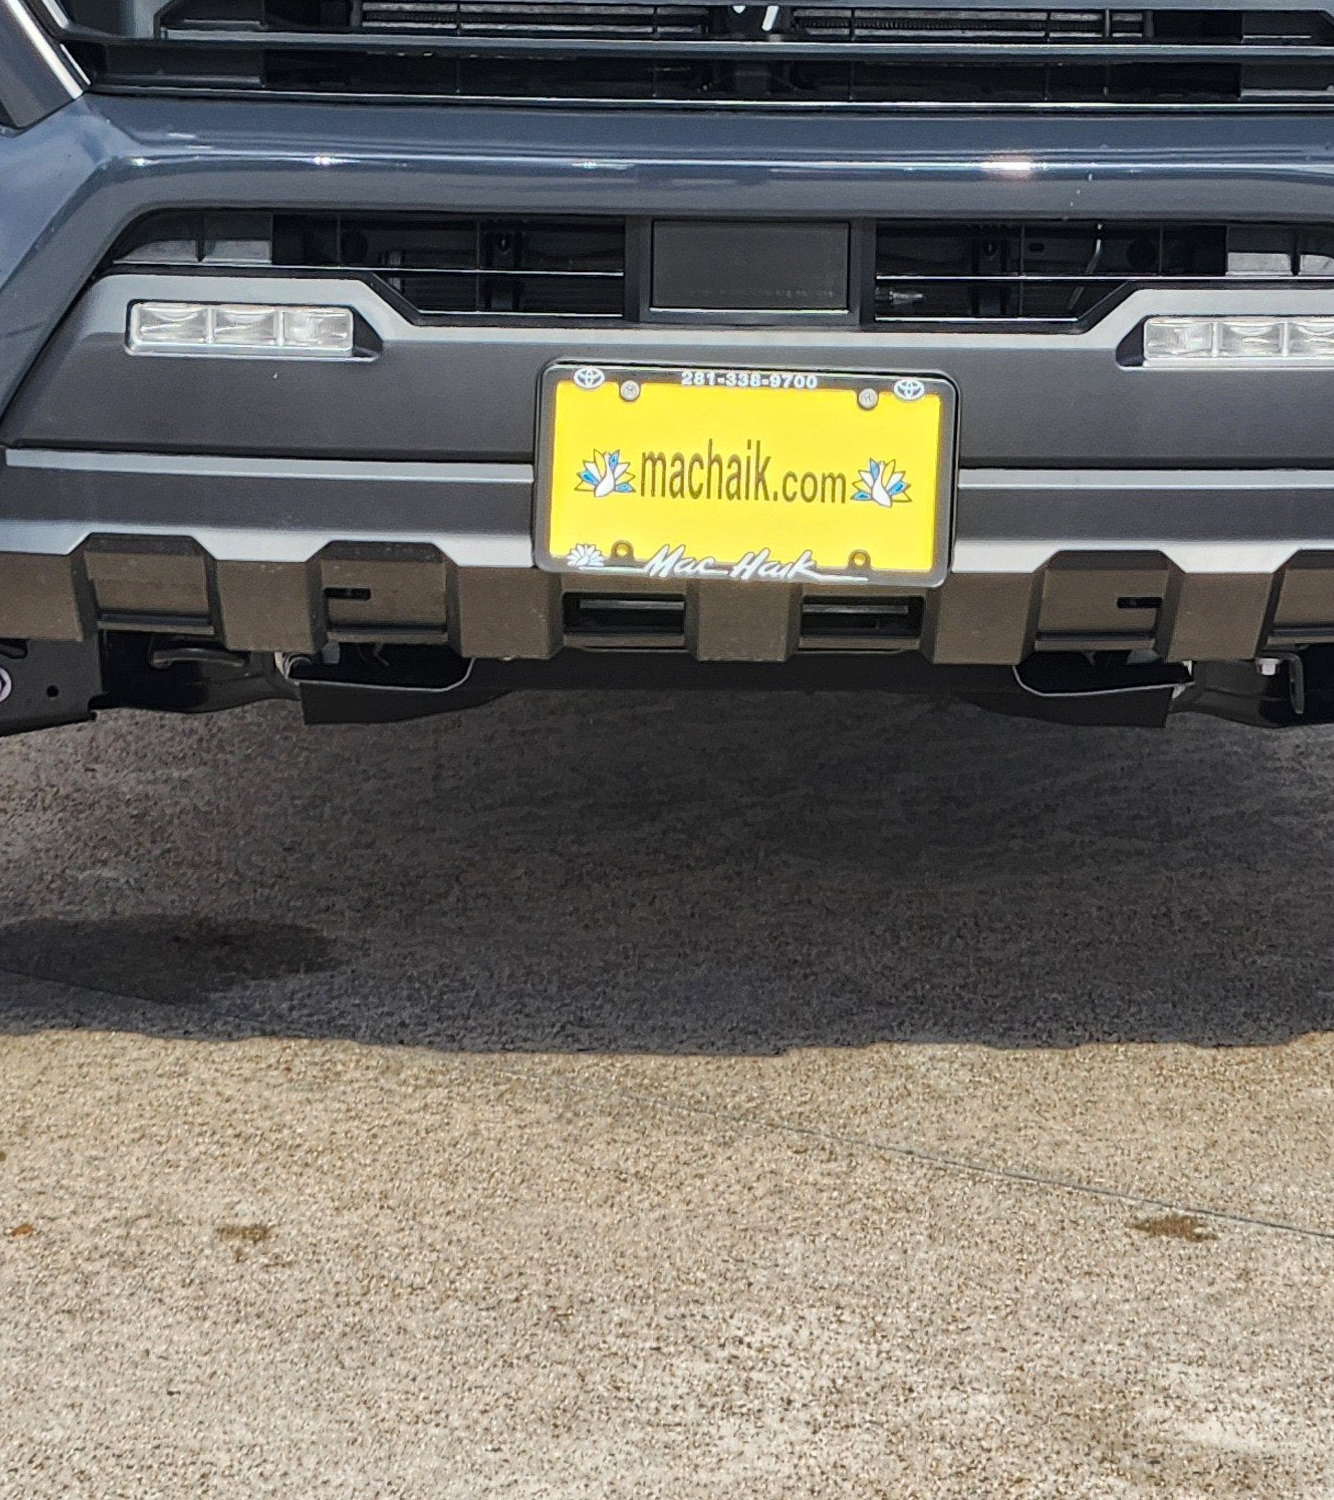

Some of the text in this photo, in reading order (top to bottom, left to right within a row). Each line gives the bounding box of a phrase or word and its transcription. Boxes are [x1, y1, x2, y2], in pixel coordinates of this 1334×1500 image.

[680, 370, 819, 392] 281-338-9700
[640, 438, 847, 504] machaik.com
[644, 543, 822, 581] Mac Haik
